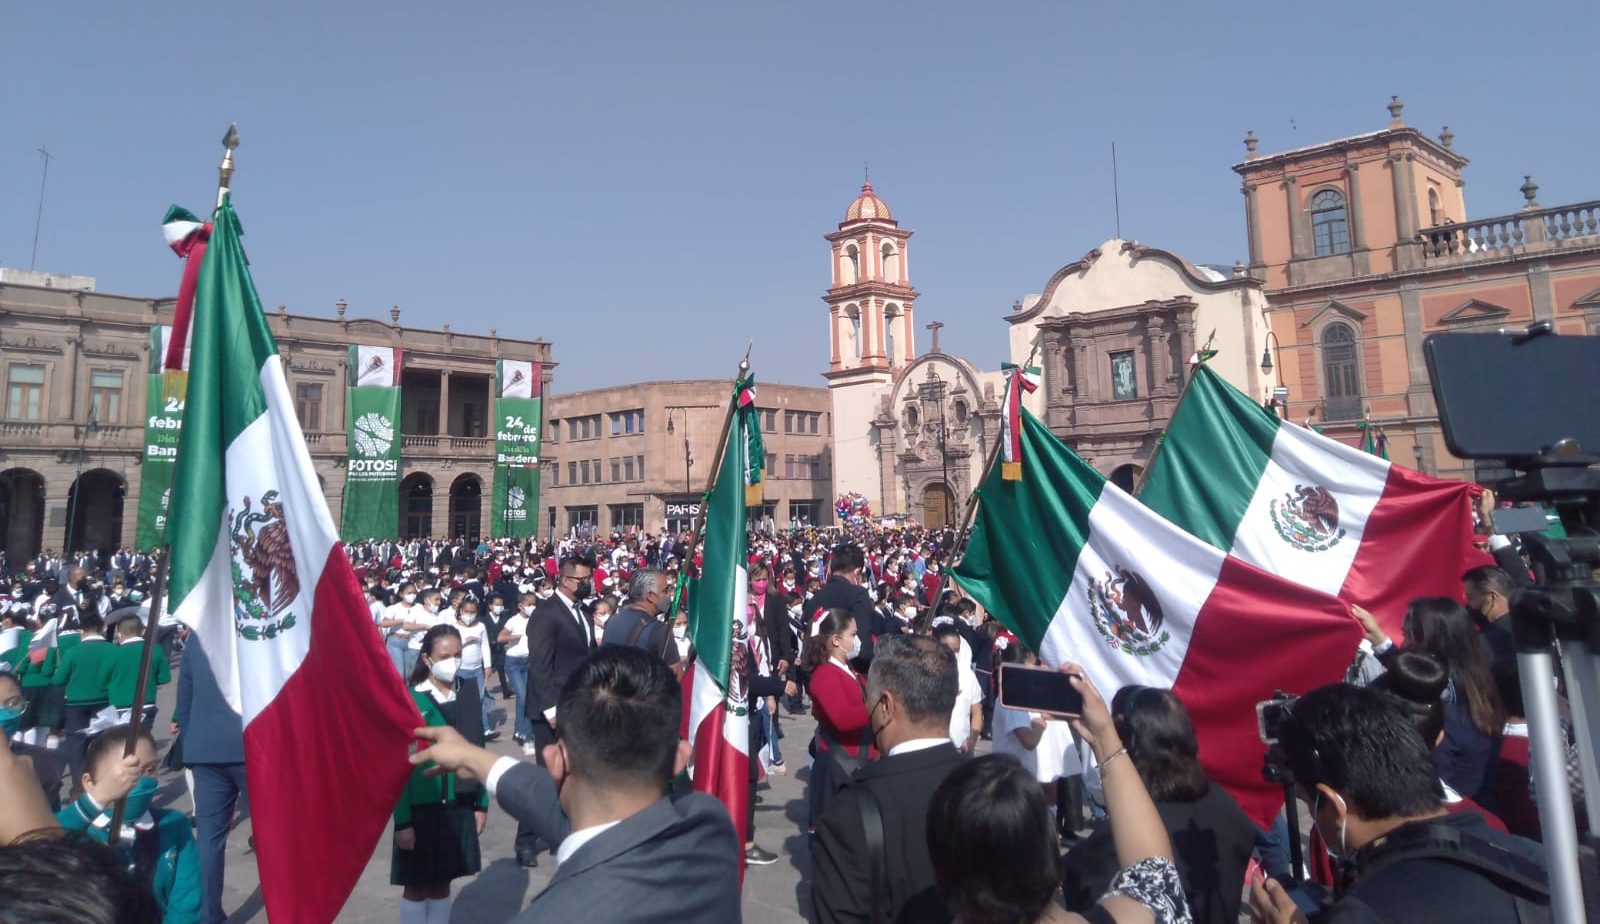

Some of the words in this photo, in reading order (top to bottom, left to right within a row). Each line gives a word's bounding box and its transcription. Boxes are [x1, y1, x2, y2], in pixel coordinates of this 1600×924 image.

[505, 416, 524, 428] 24
[523, 424, 537, 434] de
[498, 453, 538, 463] Bdera
[667, 504, 702, 515] PARIS
